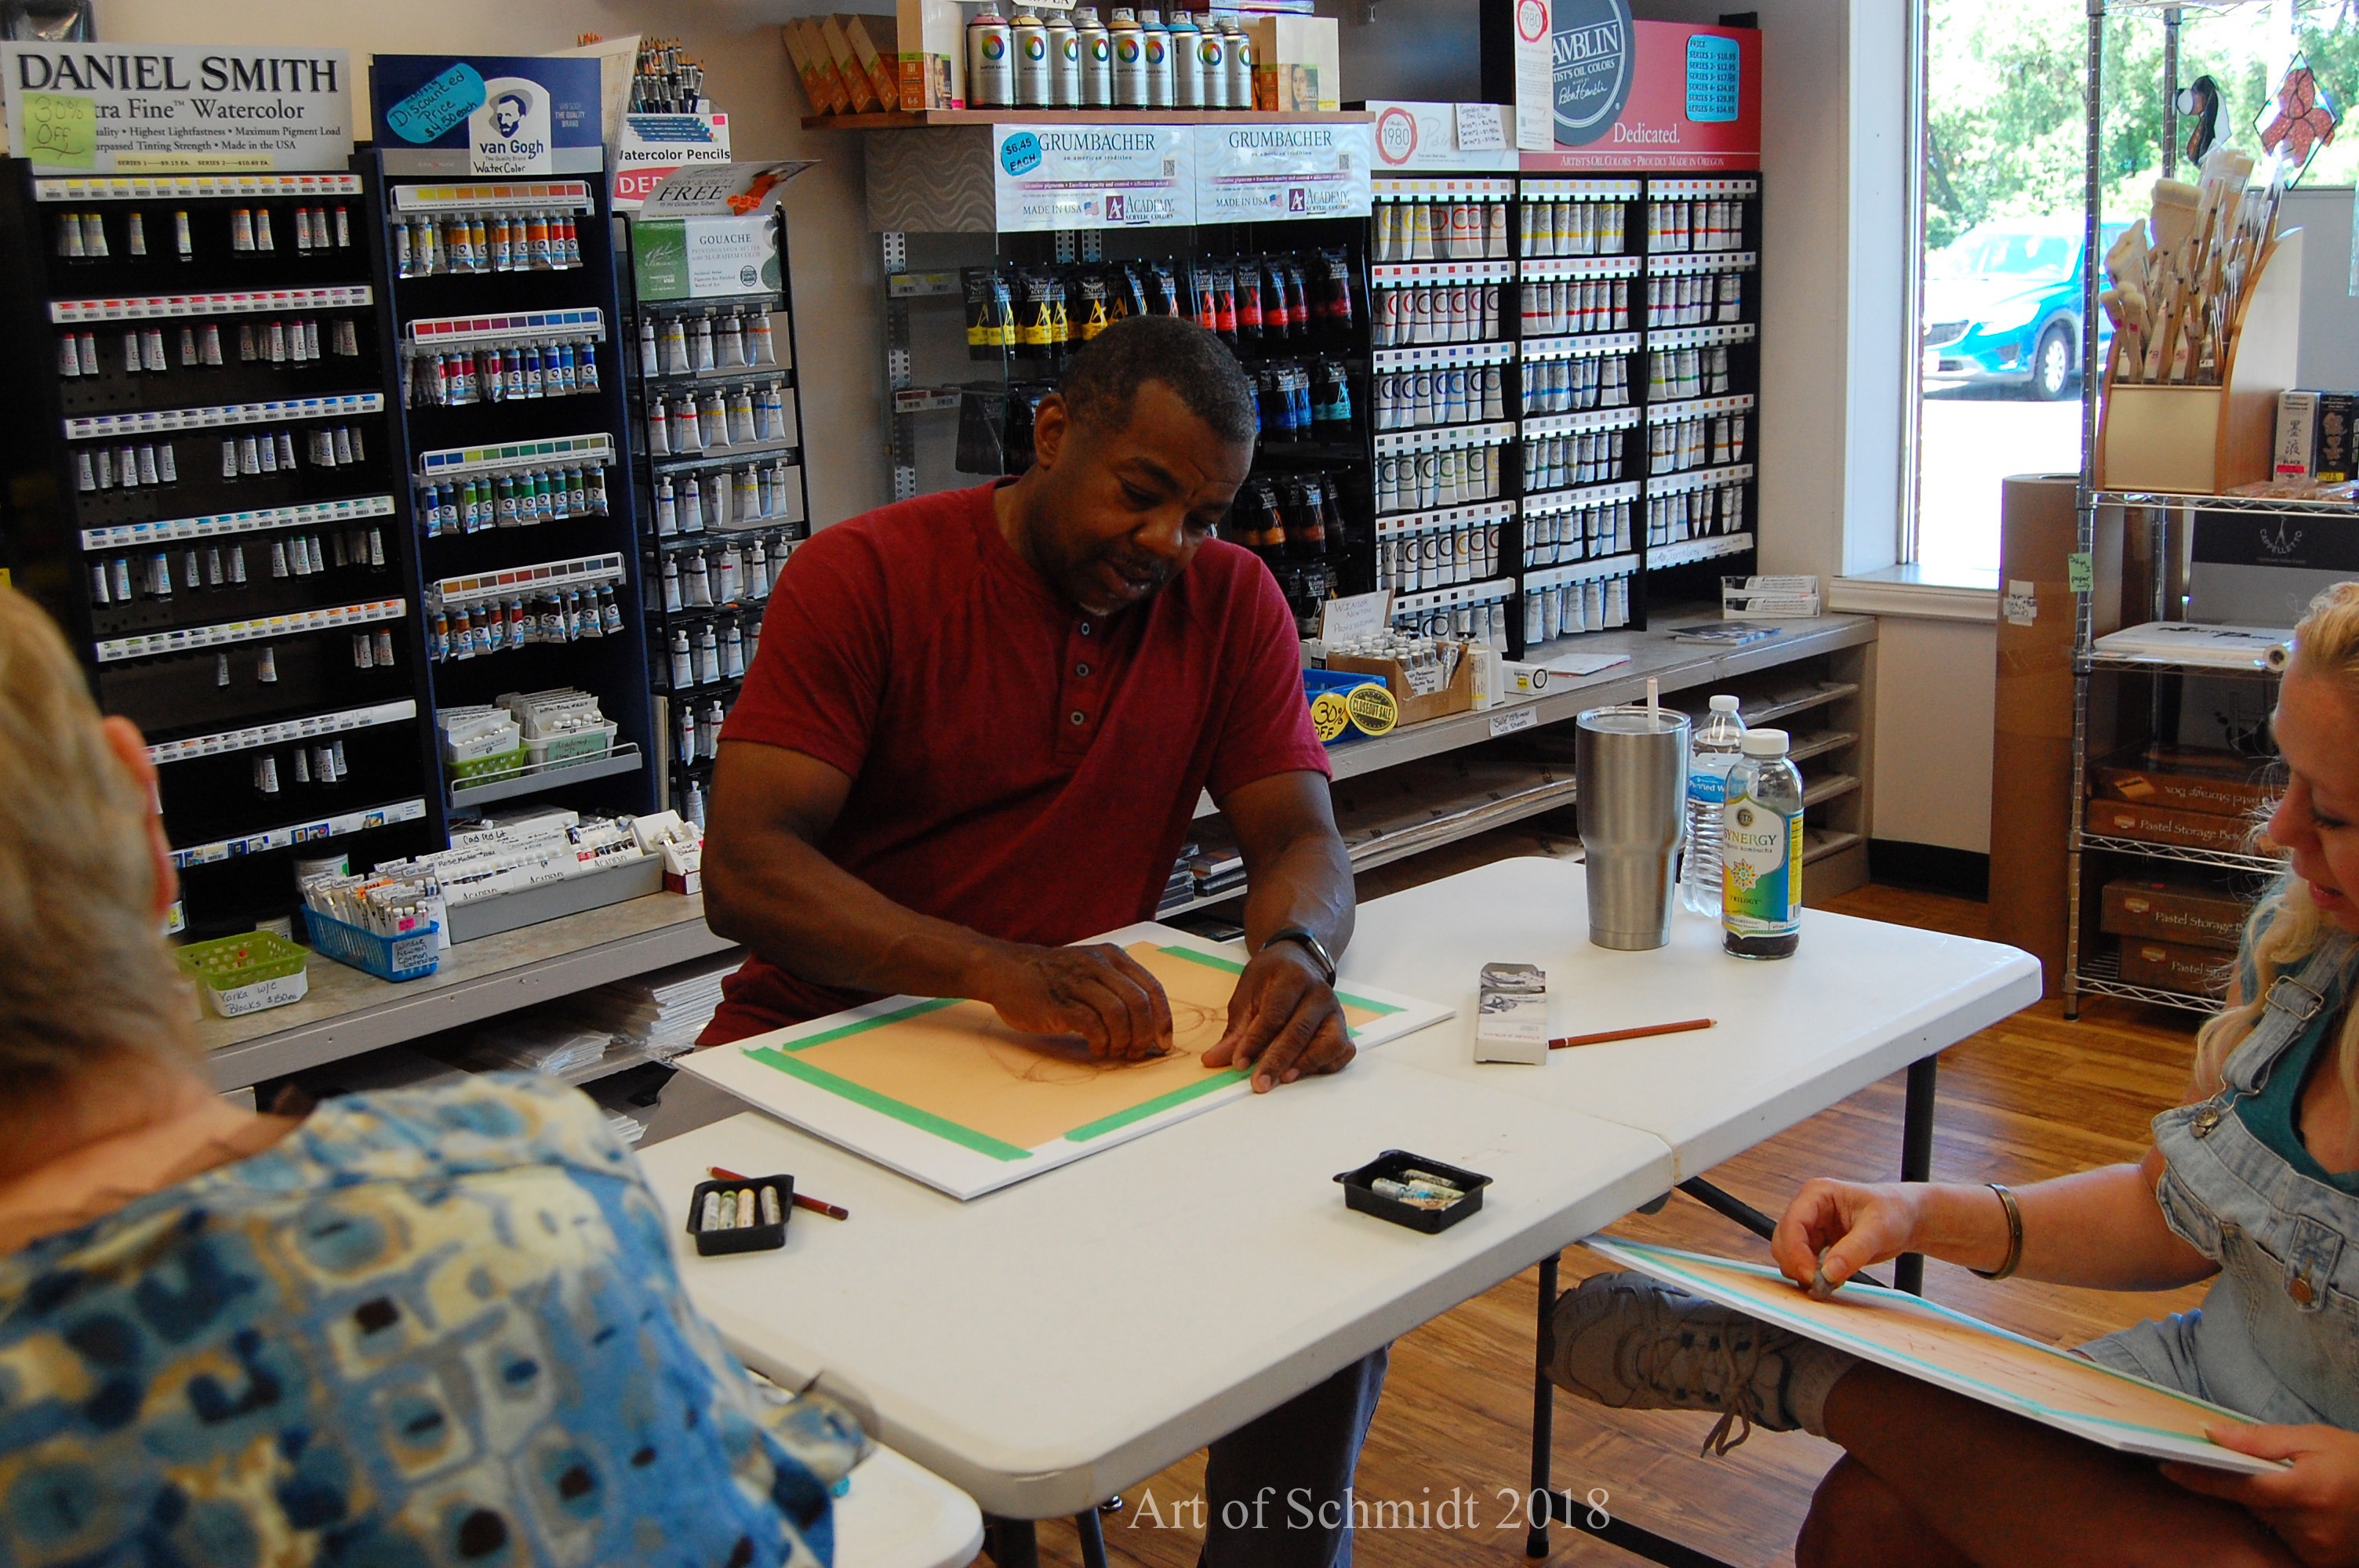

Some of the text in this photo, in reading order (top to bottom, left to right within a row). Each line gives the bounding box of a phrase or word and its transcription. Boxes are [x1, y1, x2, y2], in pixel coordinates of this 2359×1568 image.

[1520, 11, 1541, 28] 1980
[17, 53, 339, 93] DANIEL SMITH
[1573, 59, 1615, 78] OIL COLORS
[35, 96, 84, 122] 30%
[190, 98, 305, 119] Watercolor
[418, 101, 455, 123] Price
[130, 126, 166, 138] Highest
[169, 126, 226, 139] Lightfastness
[235, 126, 280, 136] Maximum
[282, 126, 318, 138] Pigment
[320, 126, 341, 136] Load
[1038, 132, 1155, 151] GRUMBACHER
[1229, 129, 1332, 148] GRUMBACHER
[1383, 127, 1410, 146] 1980
[1613, 122, 1681, 143] Dedicated.
[136, 141, 172, 153] Tinting
[174, 141, 212, 153] Strength
[222, 141, 245, 150] Made
[249, 141, 257, 150] in
[260, 141, 274, 150] the
[276, 141, 296, 150] USA
[479, 140, 543, 160] van Gogh
[687, 149, 731, 160] Pencils
[1005, 137, 1032, 156] $6.45
[1009, 154, 1037, 172] EACH
[1590, 156, 1605, 166] OIL
[1605, 156, 1632, 166] COLORS
[1669, 156, 1689, 166] MADE
[1023, 203, 1082, 216] MADE IN USA
[1216, 196, 1268, 208] MADE IN USA
[699, 234, 752, 245] GOUACHE
[1314, 702, 1347, 725] 30%
[1353, 698, 1392, 721] CLOSEOUT SALE
[2139, 820, 2172, 833] Pastel
[2173, 825, 2217, 840] Storage
[2155, 912, 2188, 925] Pastel
[2190, 917, 2234, 934] Storage
[2172, 961, 2204, 975] Pastel
